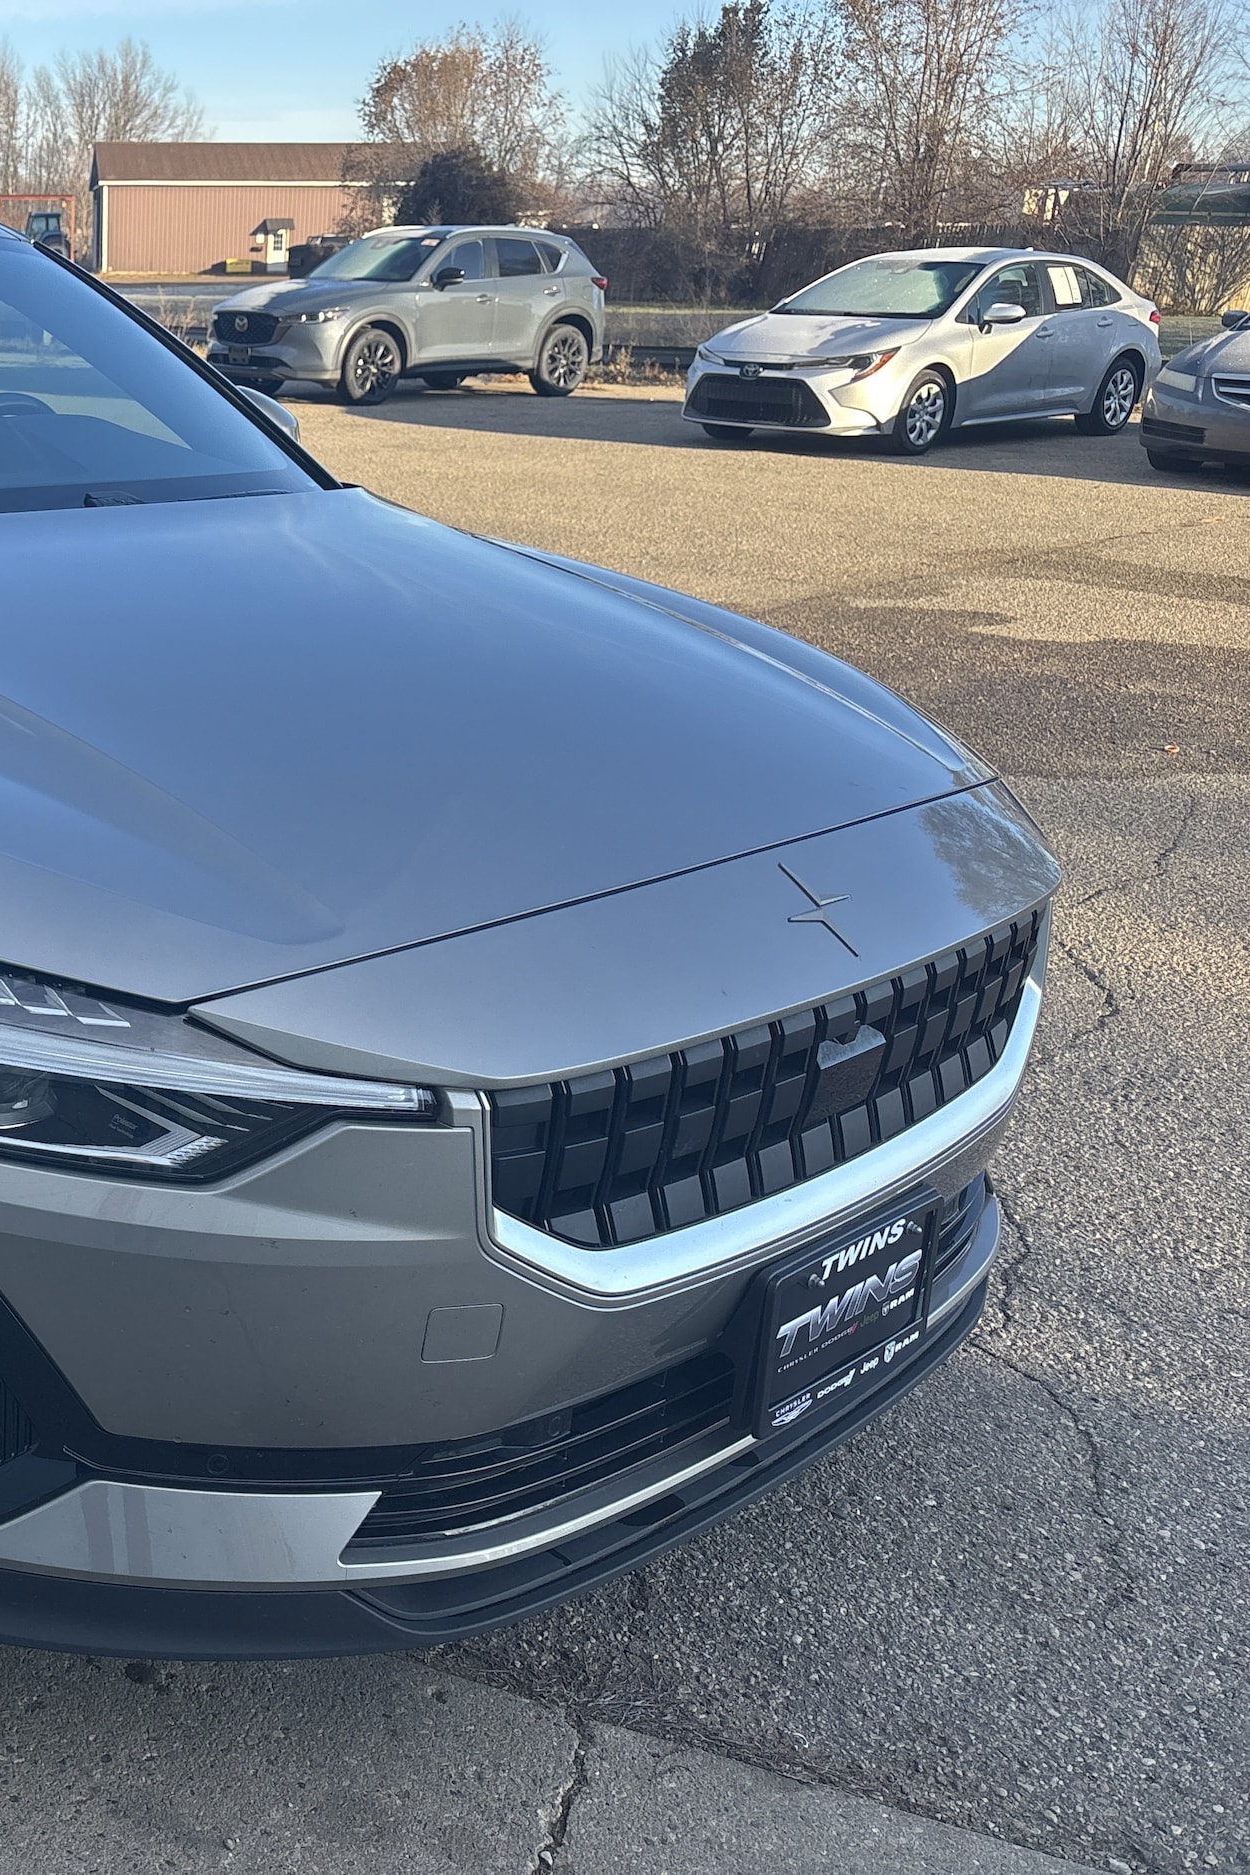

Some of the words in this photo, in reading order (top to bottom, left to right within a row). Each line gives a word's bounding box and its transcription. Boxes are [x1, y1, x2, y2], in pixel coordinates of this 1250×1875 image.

[821, 1218, 906, 1281] TWINS
[776, 1249, 922, 1358] TWINS
[777, 1346, 819, 1373] CHRYSLER
[860, 1311, 880, 1328] Jeep
[889, 1288, 915, 1310] RAM
[775, 1393, 811, 1418] CHRYSLER
[860, 1357, 879, 1374] Jeep
[894, 1330, 920, 1352] RAM
